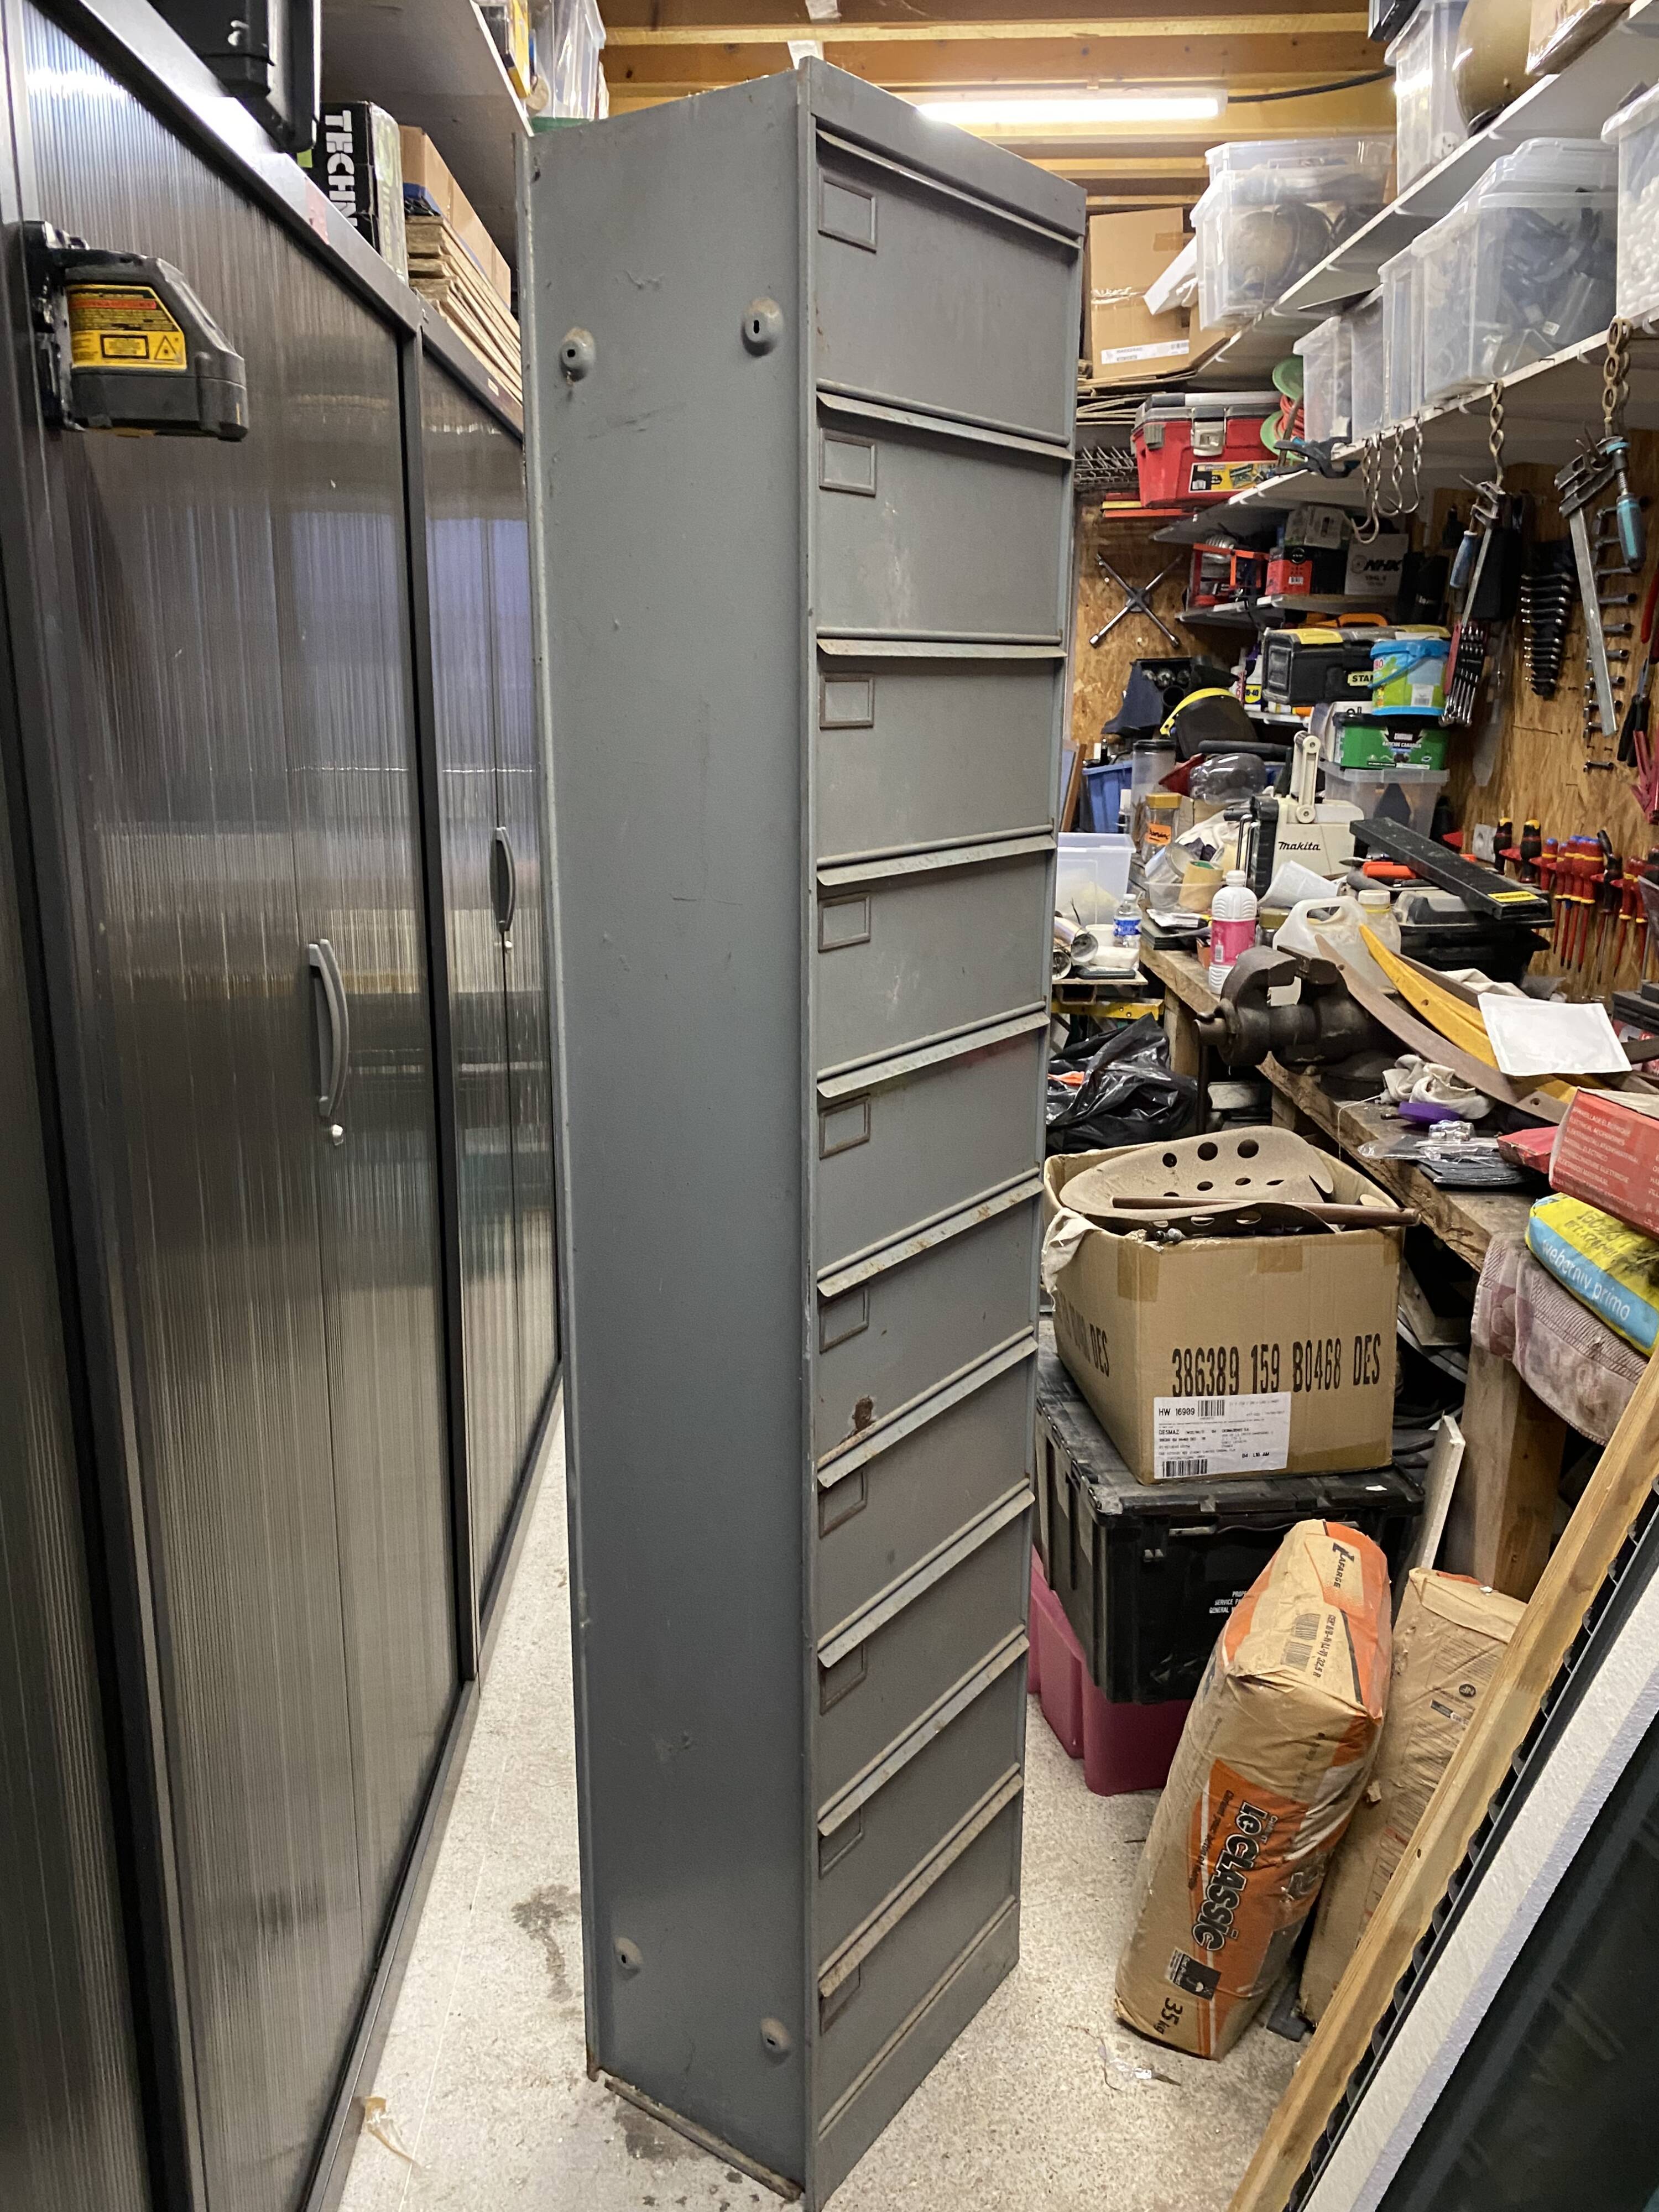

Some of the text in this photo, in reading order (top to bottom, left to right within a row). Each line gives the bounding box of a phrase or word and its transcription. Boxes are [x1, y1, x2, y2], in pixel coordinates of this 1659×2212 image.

[1592, 1282, 1631, 1321] primo
[1172, 1333, 1381, 1397] 386389 159 B0468 DES
[1332, 1542, 1355, 1589] LAFARGE
[1154, 2019, 1171, 2035] kg
[1161, 1997, 1183, 2026] 35
